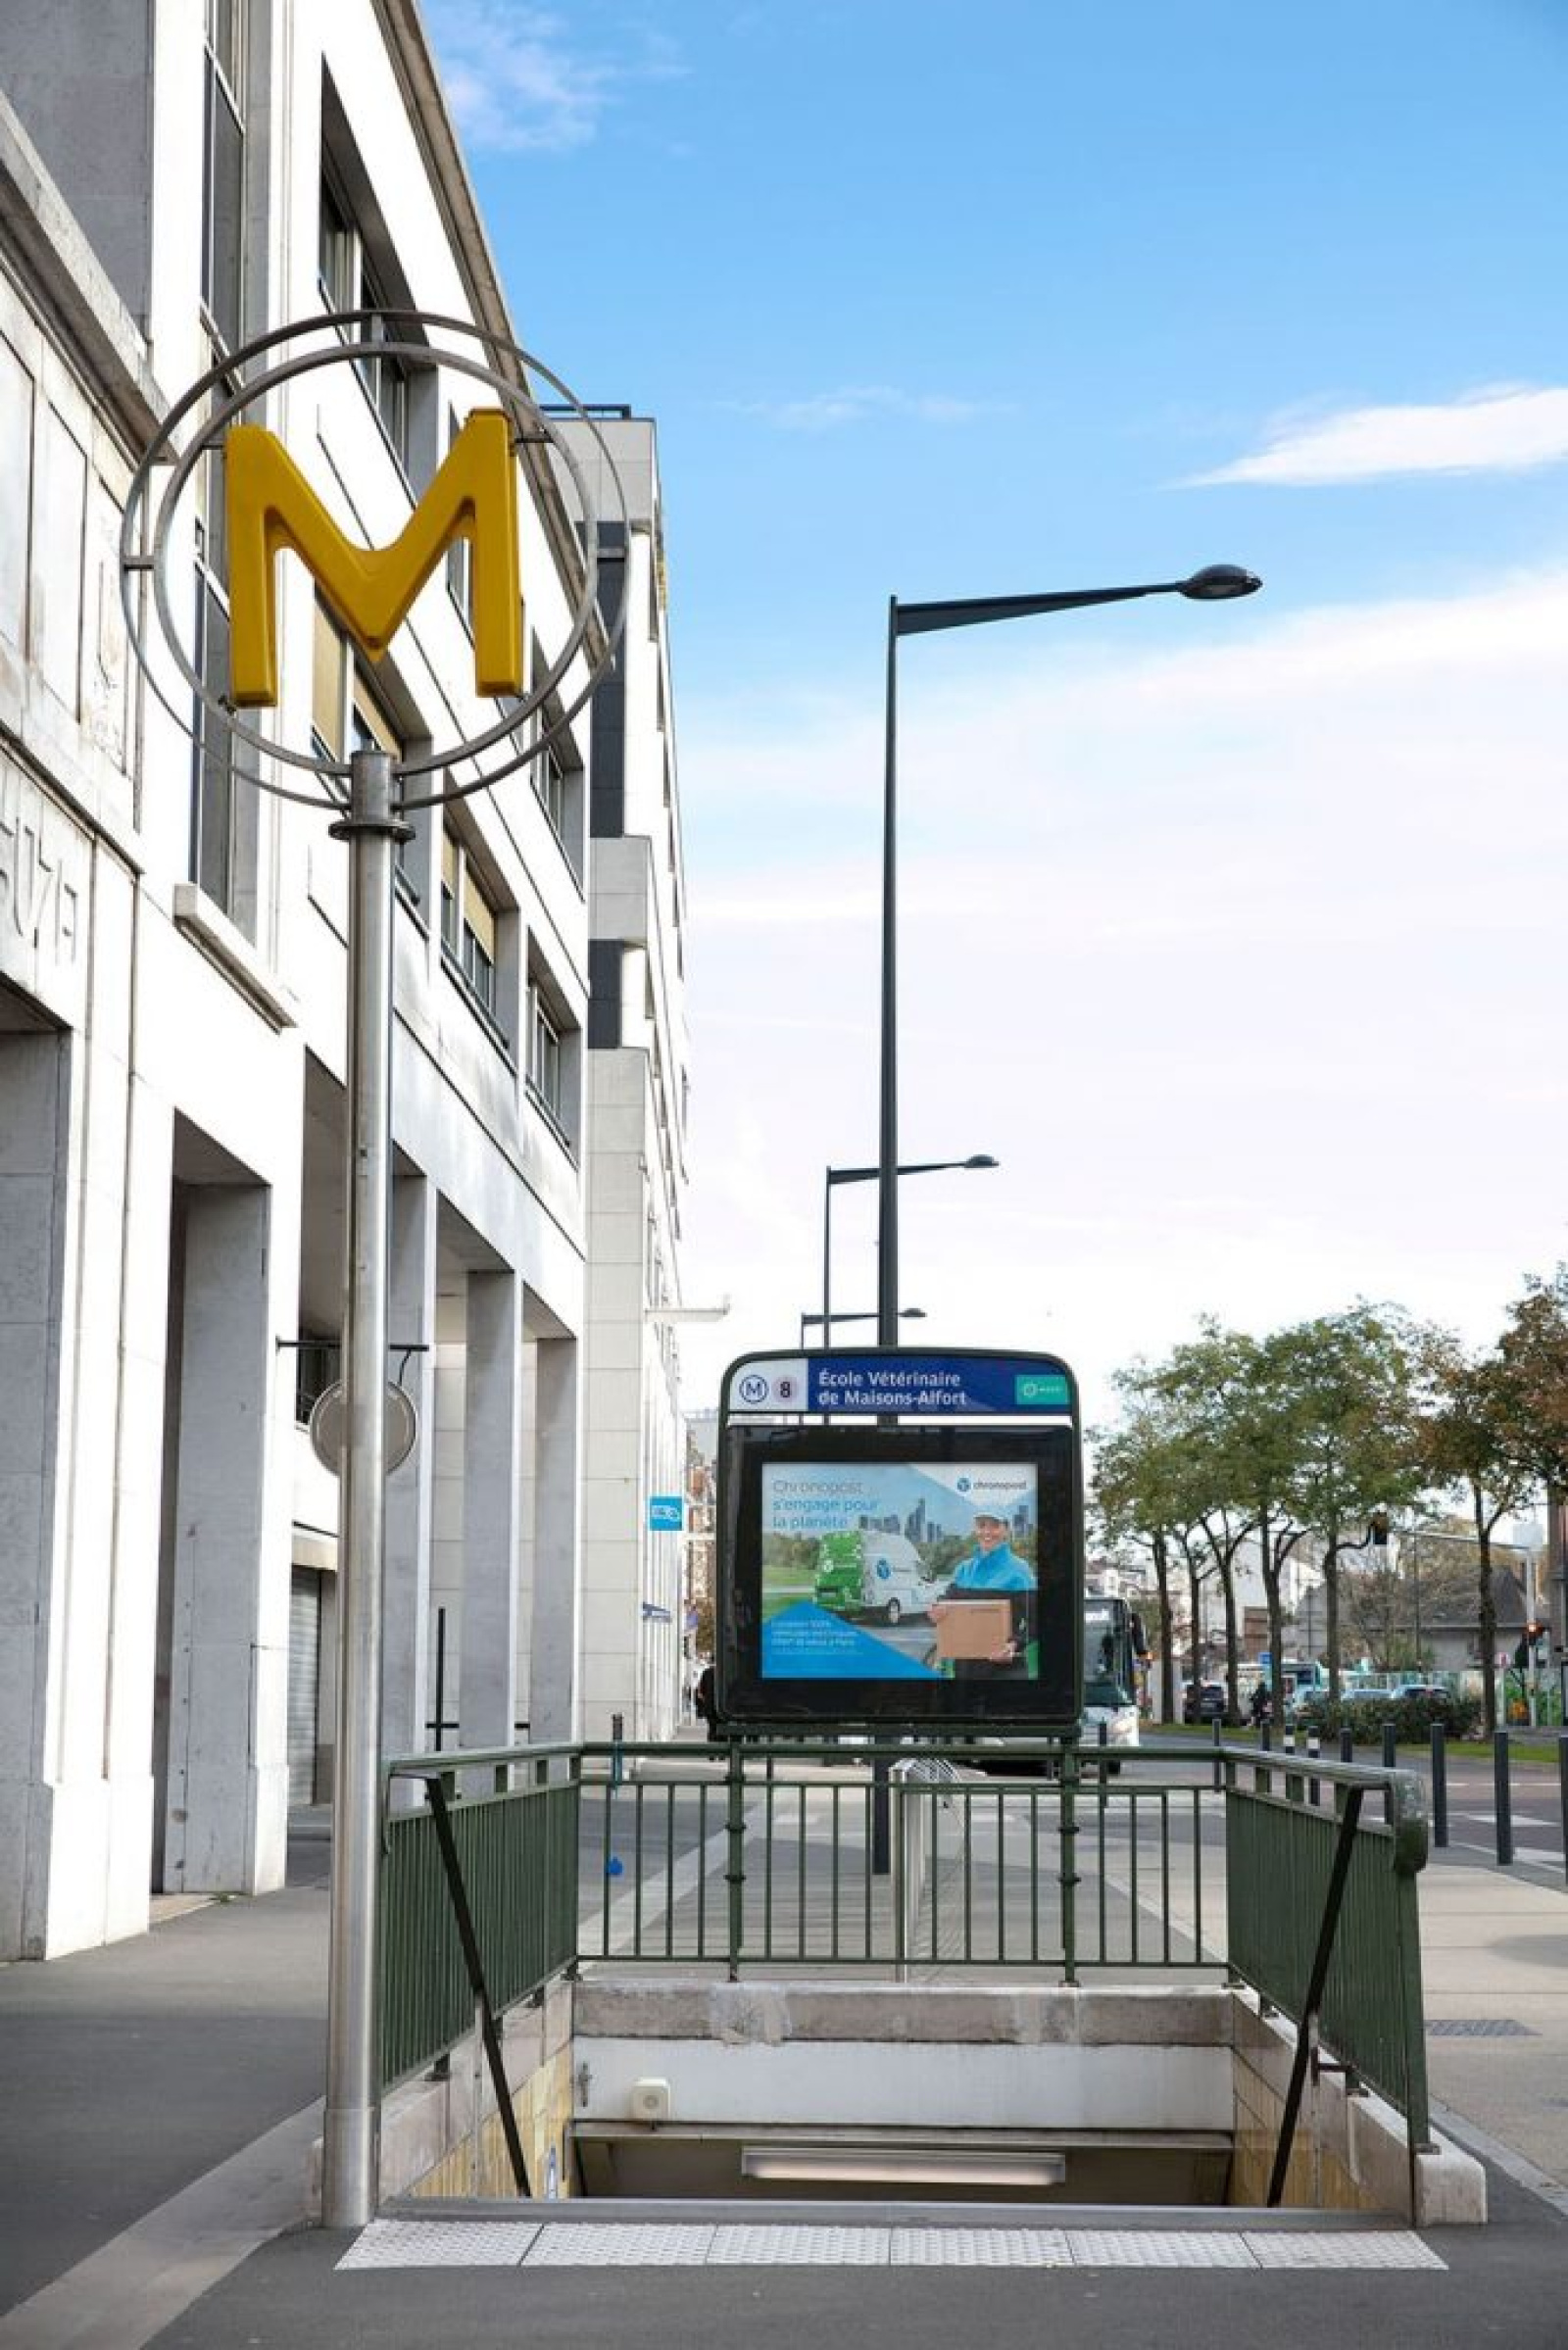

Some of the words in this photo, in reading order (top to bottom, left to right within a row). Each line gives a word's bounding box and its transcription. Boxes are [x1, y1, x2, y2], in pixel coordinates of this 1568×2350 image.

[224, 407, 525, 708] M
[818, 1368, 862, 1387] École
[868, 1371, 960, 1387] Vétérinaire
[780, 1381, 790, 1397] 8
[818, 1390, 839, 1405] de
[845, 1390, 966, 1405] Maisons-Alfort
[772, 1498, 840, 1512] s'engage
[844, 1500, 878, 1513] pour
[772, 1517, 787, 1528] la
